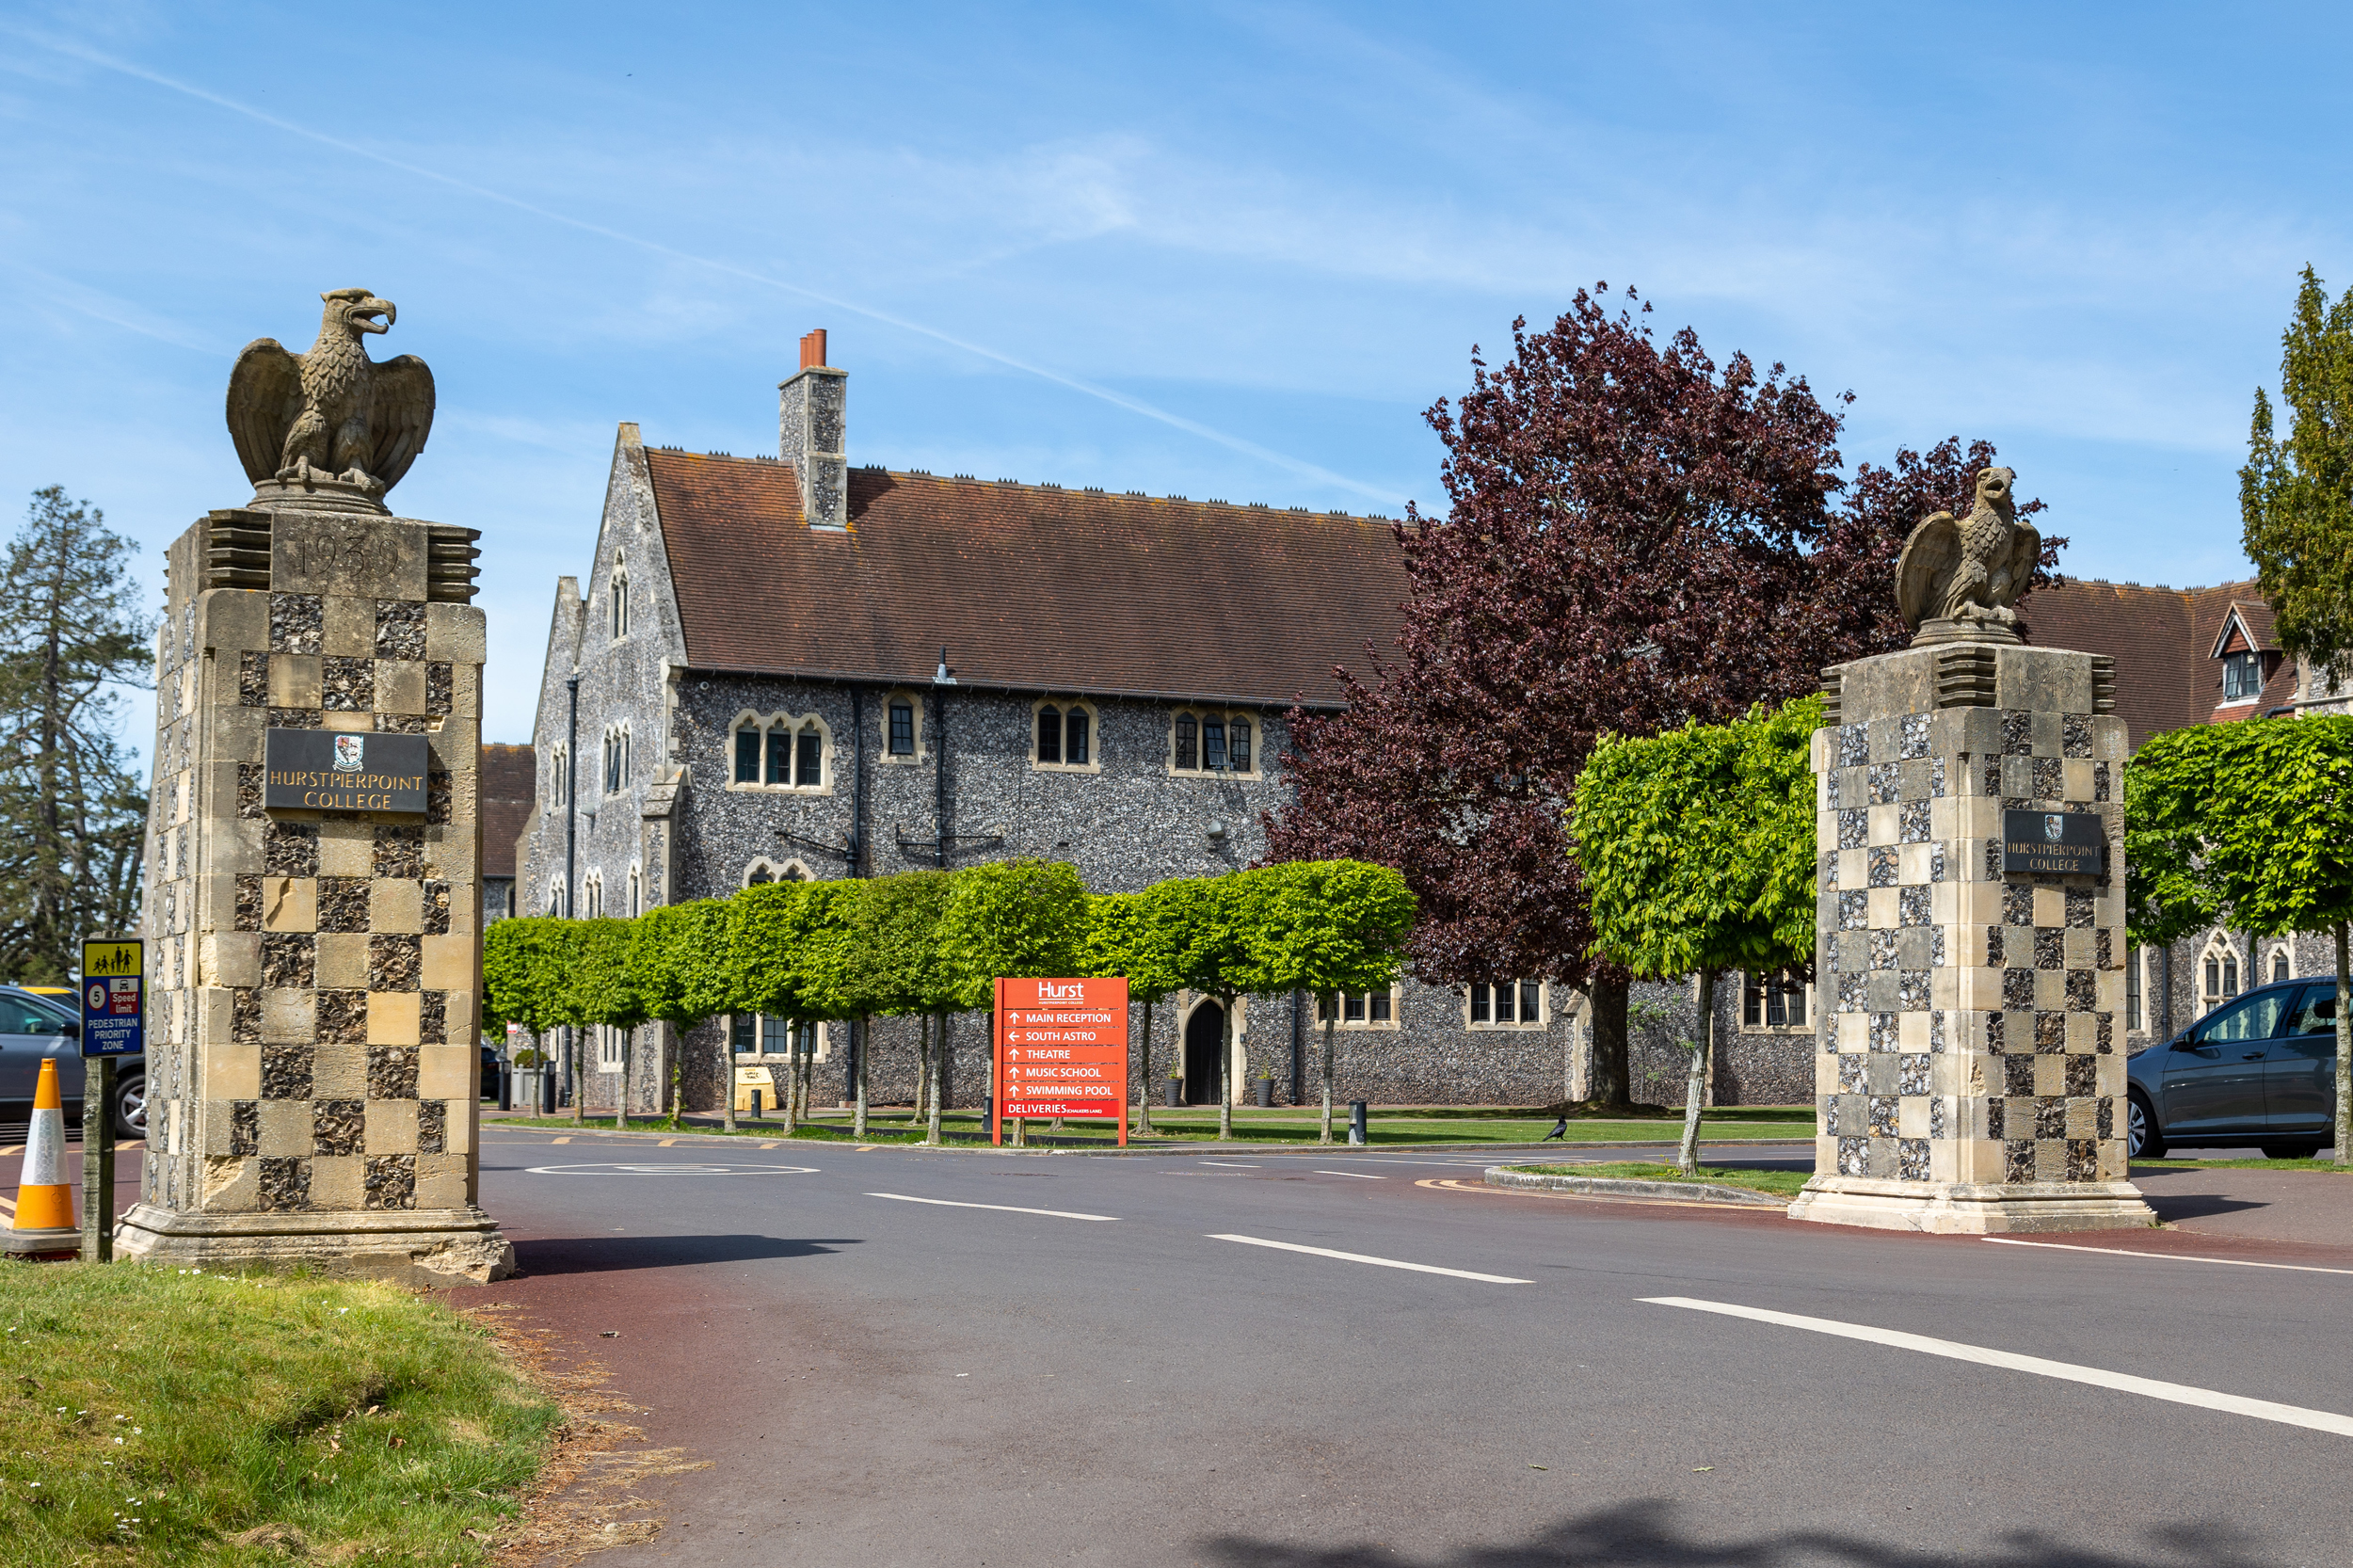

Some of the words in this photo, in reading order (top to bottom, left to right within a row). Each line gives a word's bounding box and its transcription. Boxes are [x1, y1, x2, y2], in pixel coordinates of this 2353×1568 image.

[301, 535, 399, 579] 1939
[2017, 664, 2075, 698] 1945
[270, 771, 424, 791] HURSTPIERPOINT
[304, 791, 392, 809] COLLEGE
[2008, 842, 2100, 857] HURSTPIERPOINT
[2029, 858, 2079, 872] COLLEGE
[1038, 981, 1084, 998] Hurst
[93, 991, 100, 1002] 5
[112, 993, 136, 1003] Speed
[116, 1004, 133, 1014] limit
[88, 1017, 138, 1029] PEDESTRIAN
[1026, 1014, 1054, 1023] MAIN
[1056, 1014, 1111, 1023] RECEPTION
[94, 1029, 132, 1040] PRIORITY
[1026, 1032, 1061, 1041] SOUTH
[1063, 1032, 1096, 1041] ASTRO
[102, 1040, 124, 1050] ZONE
[1026, 1049, 1071, 1059] THEATRE
[1026, 1067, 1059, 1078] MUSIC
[1060, 1067, 1101, 1078] SCHOOL
[1026, 1085, 1082, 1096] SWIMMING
[1085, 1085, 1112, 1096] POOL
[1008, 1104, 1066, 1113] DELIVERIES
